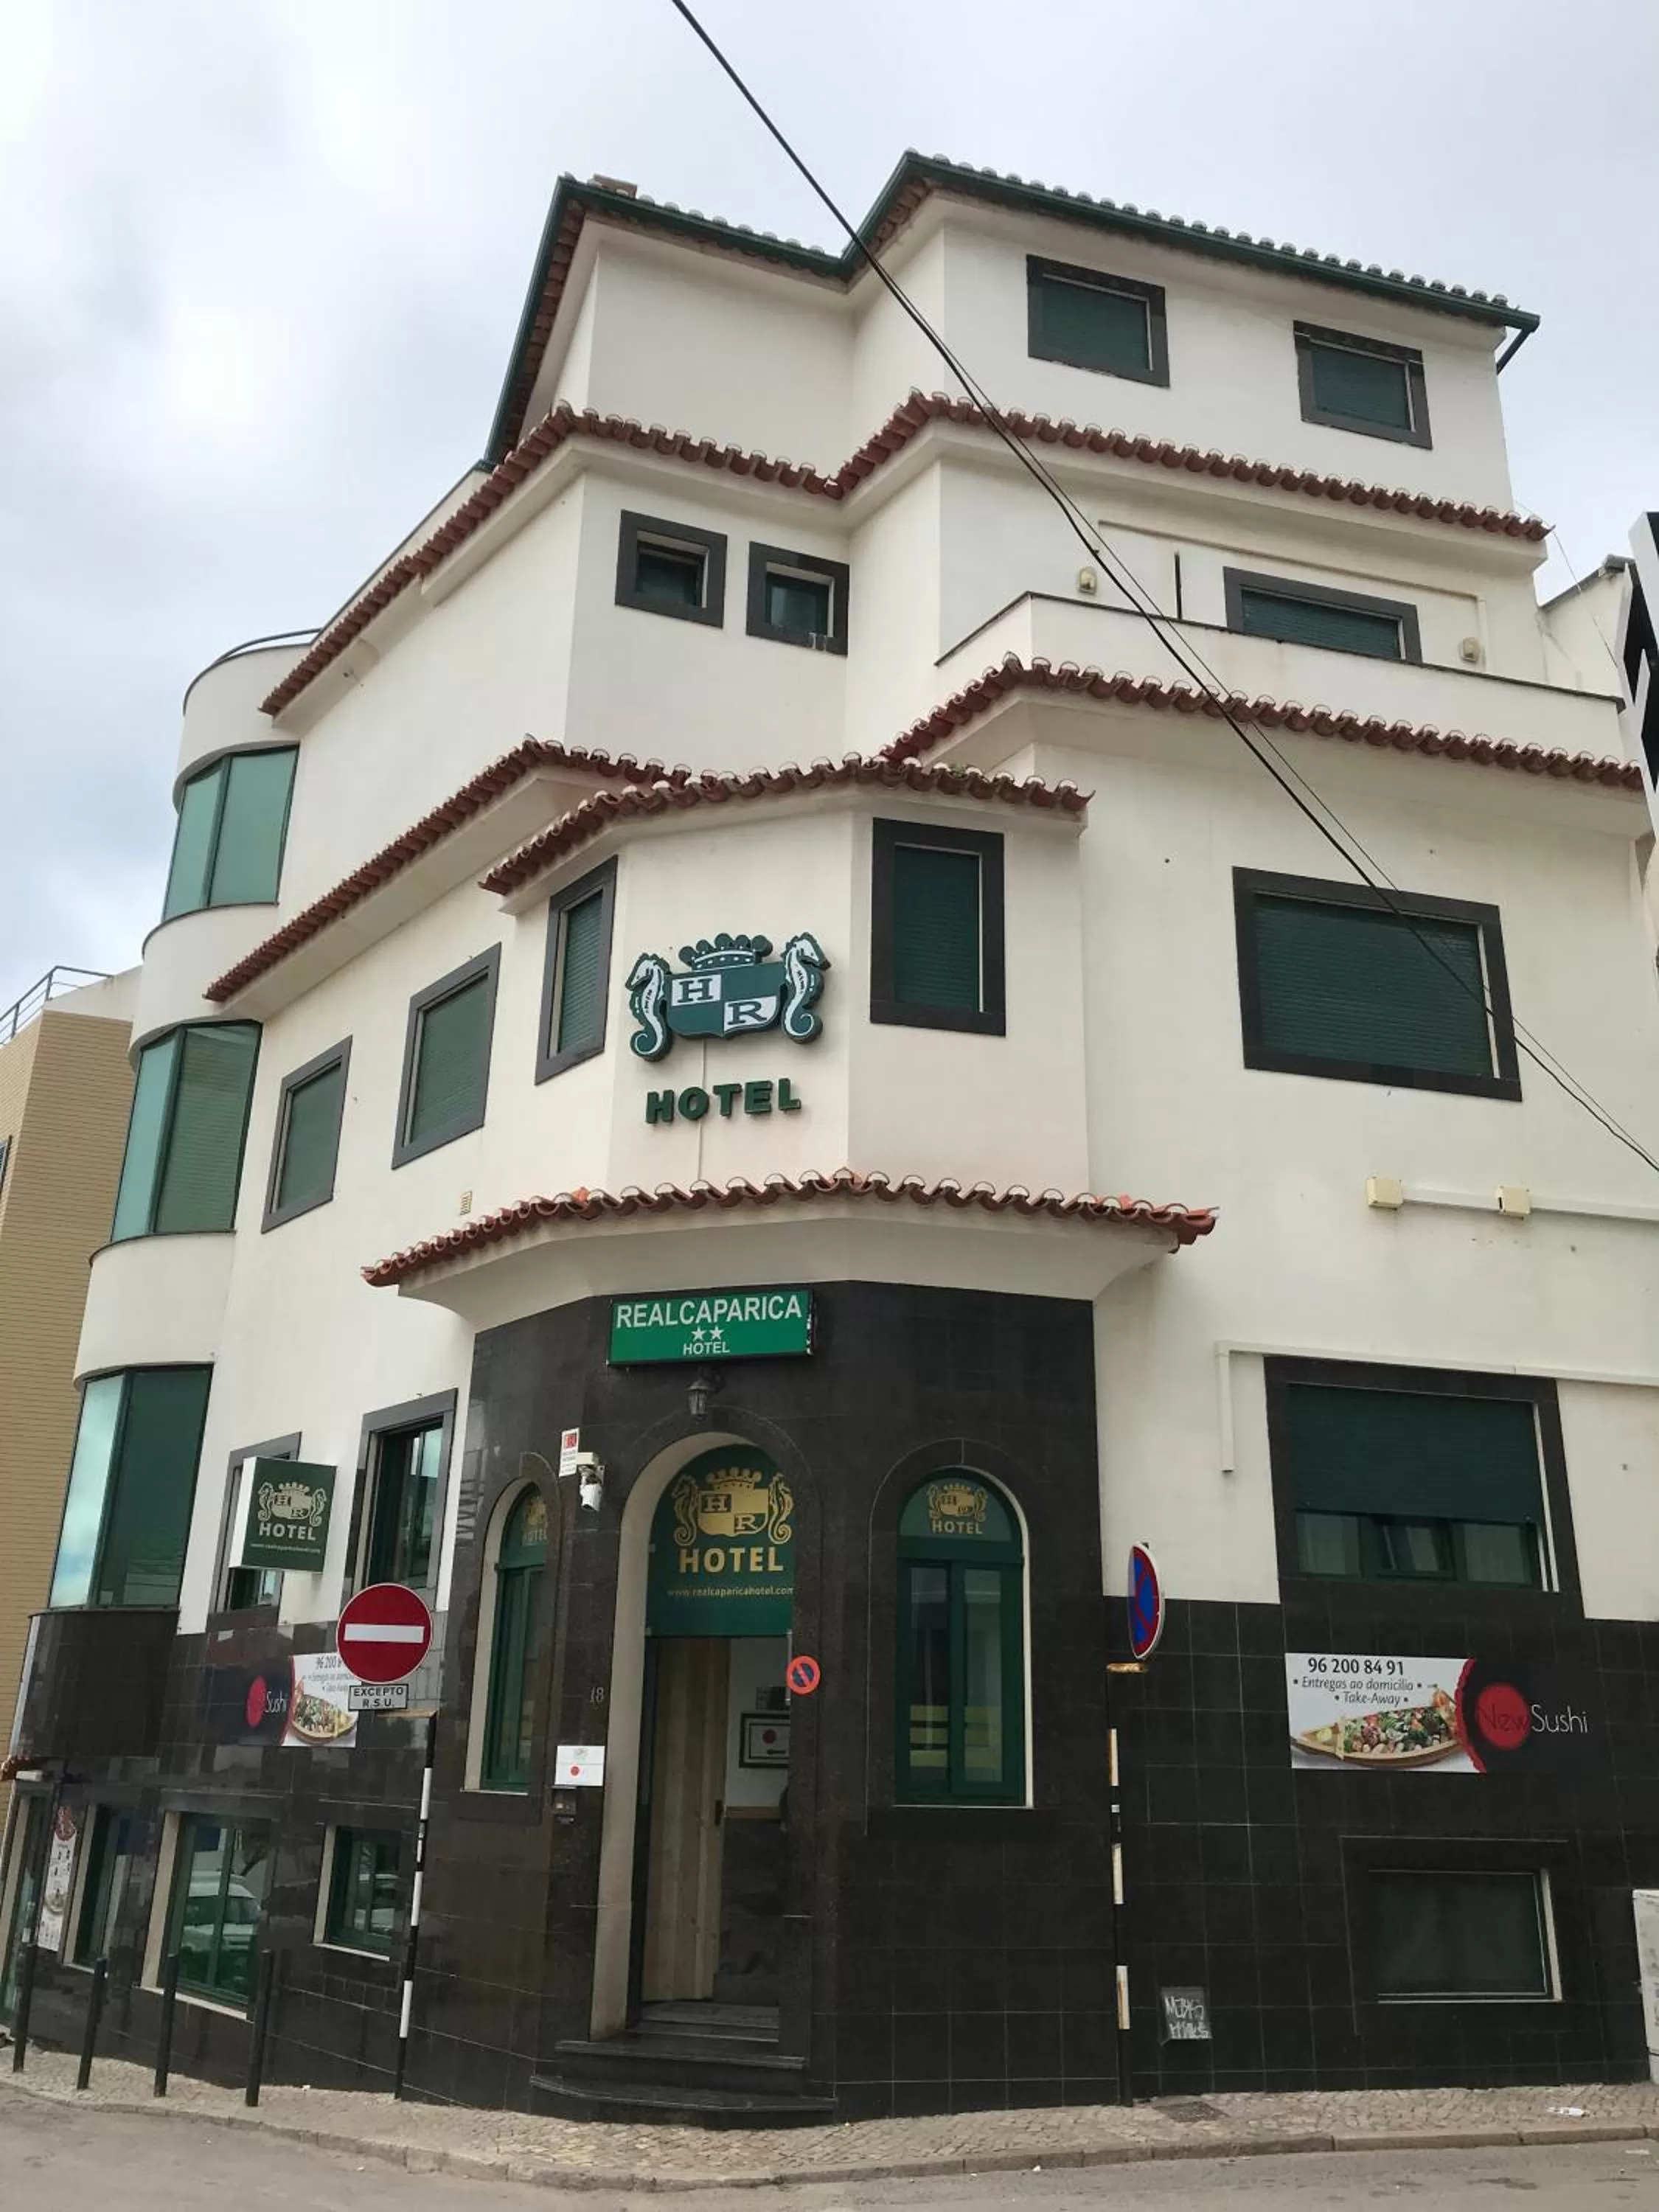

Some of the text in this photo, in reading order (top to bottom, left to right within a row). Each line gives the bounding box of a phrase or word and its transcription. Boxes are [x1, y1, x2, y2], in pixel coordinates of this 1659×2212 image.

[678, 978, 714, 1004] H
[727, 1001, 768, 1026] R
[645, 1078, 801, 1124] HOTEL
[616, 1295, 803, 1328] REALCAPARICA
[683, 1341, 731, 1355] HOTEL
[704, 1495, 728, 1511] H
[734, 1514, 759, 1530] R
[932, 1520, 983, 1534] HOTEL
[259, 1522, 316, 1541] HOTEL
[679, 1546, 785, 1573] HOTEL
[1308, 1657, 1404, 1676] 96 200 84 91
[353, 1686, 403, 1697] EXCEPTO
[1301, 1676, 1347, 1692] Entregas
[1349, 1680, 1363, 1690] ao
[590, 1686, 604, 1703] 18
[1343, 1691, 1401, 1708] Take-Away
[1531, 1704, 1588, 1733] Sushi
